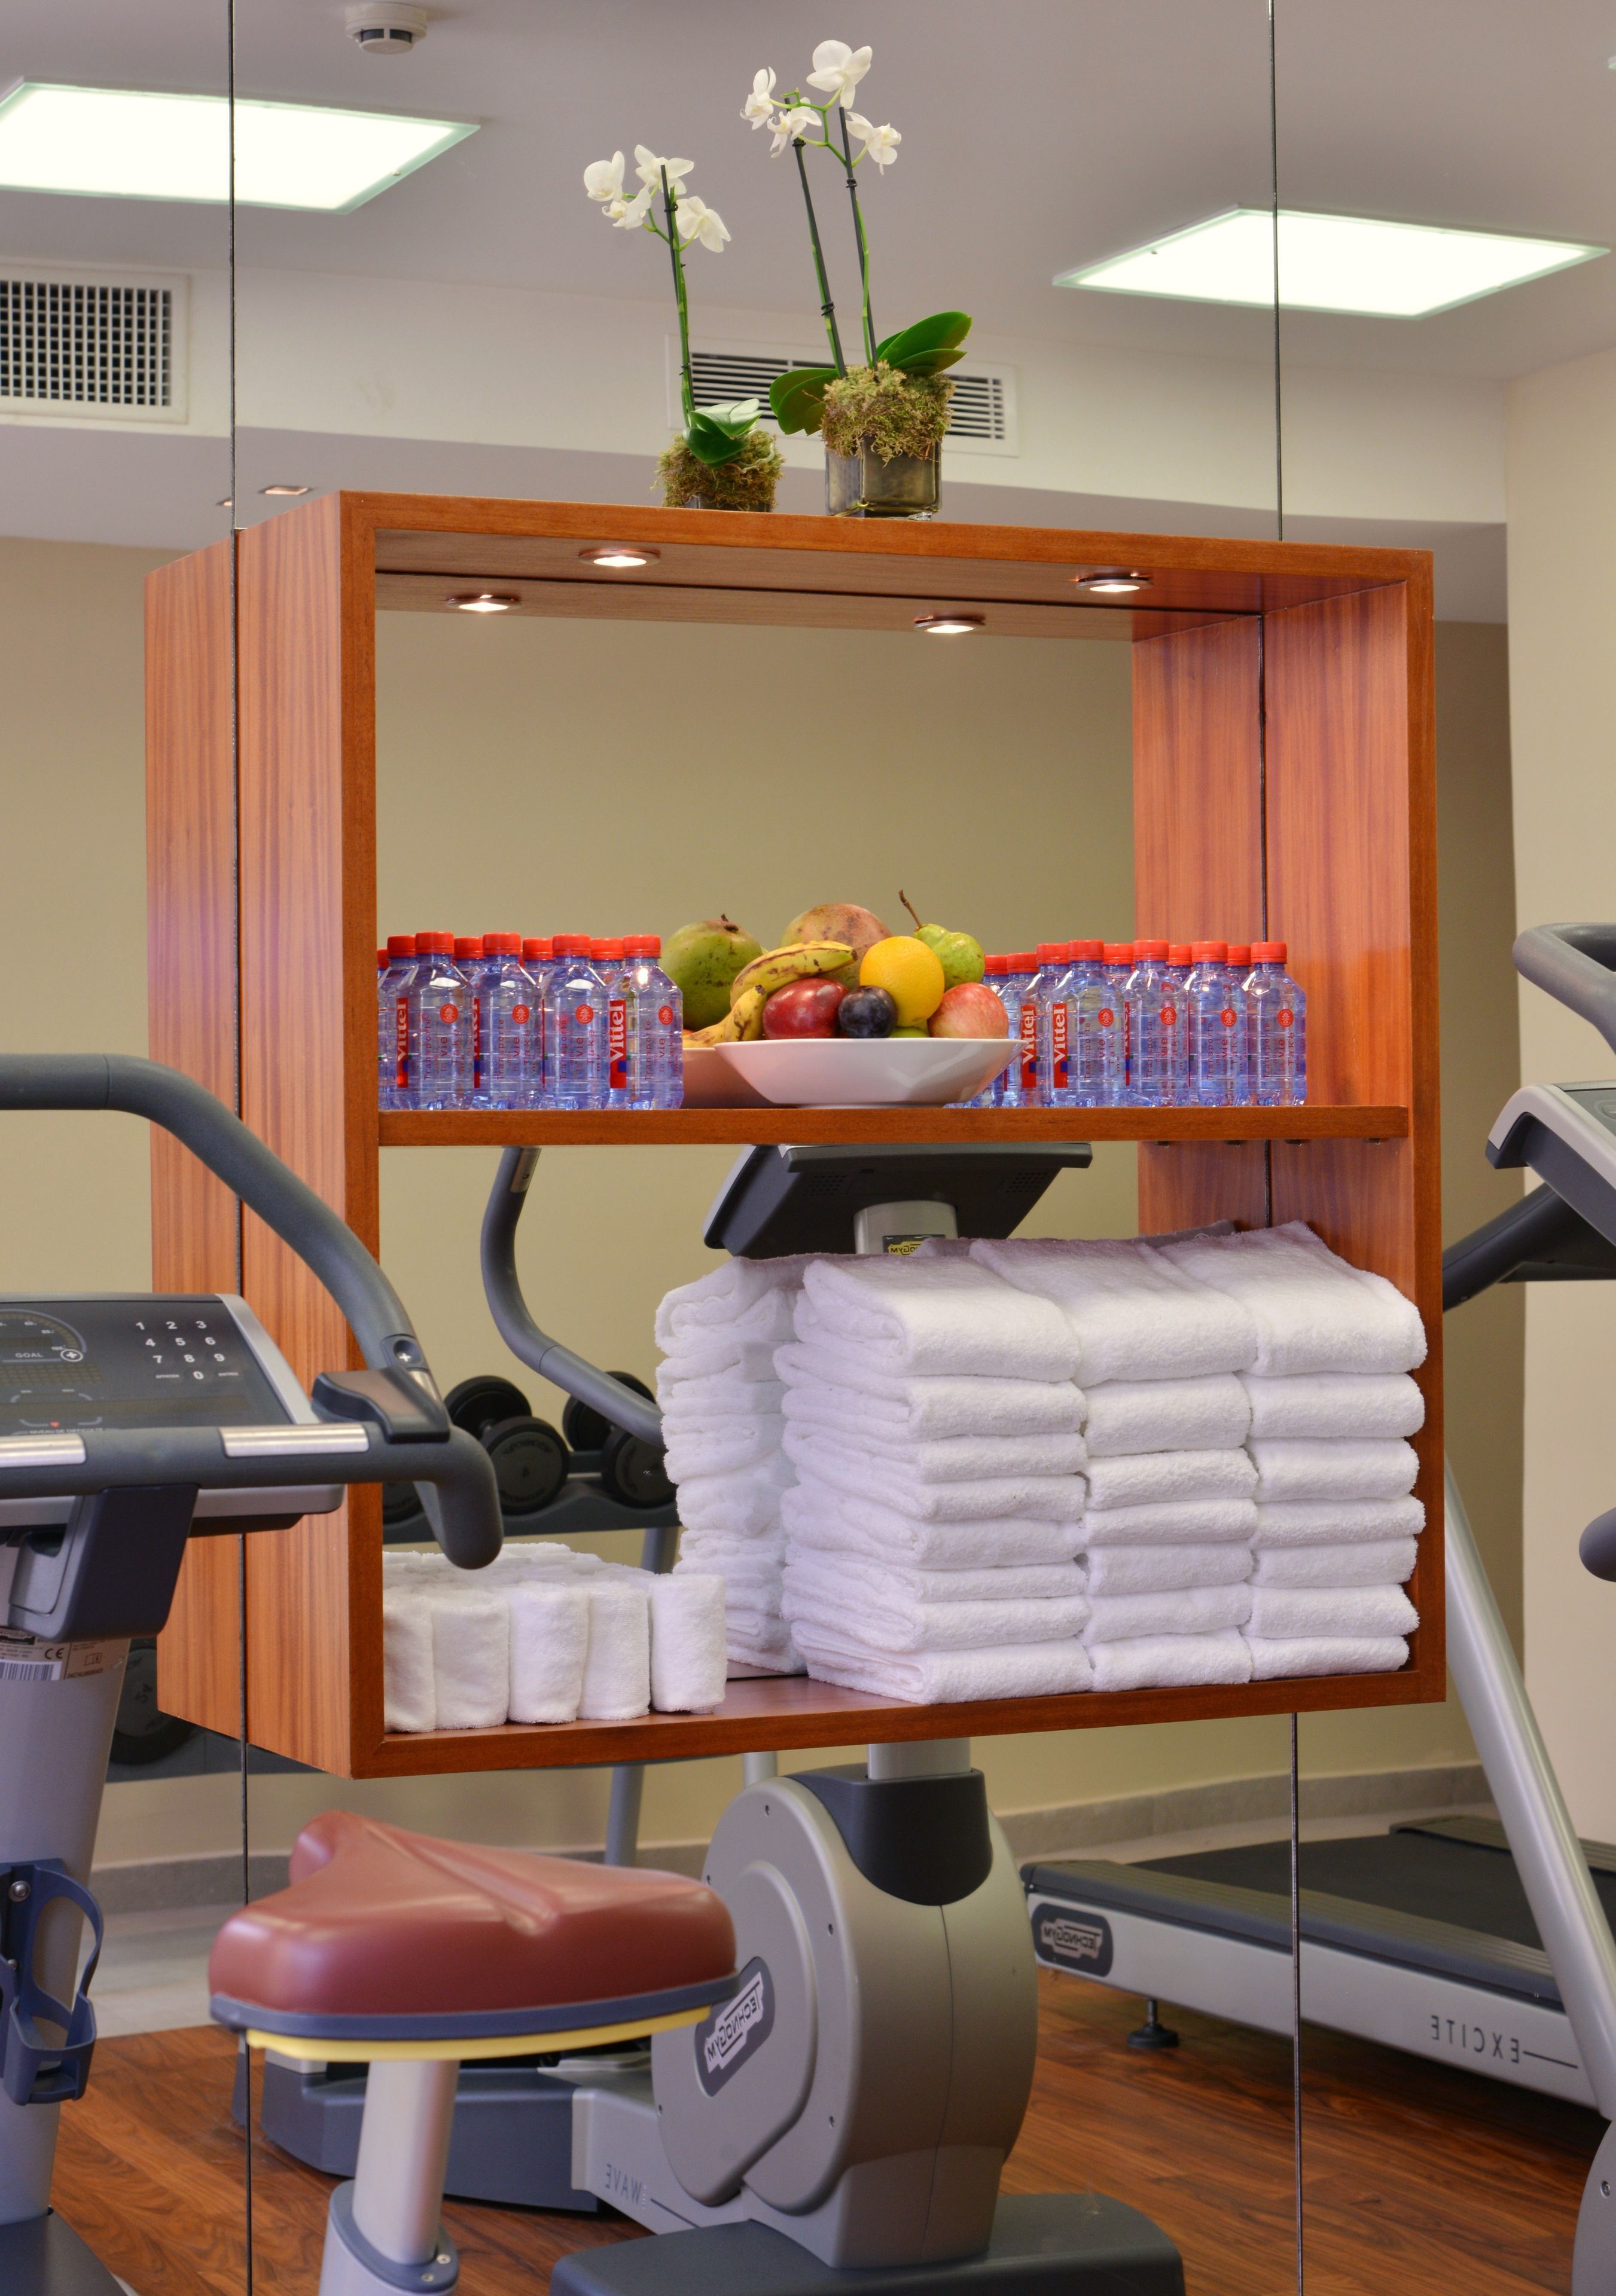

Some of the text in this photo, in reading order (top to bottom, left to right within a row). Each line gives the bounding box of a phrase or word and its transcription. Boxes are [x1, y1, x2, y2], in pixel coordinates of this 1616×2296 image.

[397, 1003, 406, 1061] Vittel
[609, 1005, 624, 1062] Vittel
[1054, 1007, 1065, 1064] Vittel
[438, 1037, 447, 1056] vie
[511, 1037, 520, 1057] vie
[574, 1037, 583, 1057] vie
[1159, 1037, 1167, 1056] vie
[166, 1321, 177, 1330] 2
[145, 1338, 155, 1347] 4
[175, 1338, 185, 1346] 5
[153, 1355, 162, 1363] 7
[184, 1354, 195, 1363] 8
[193, 1371, 204, 1379] 0
